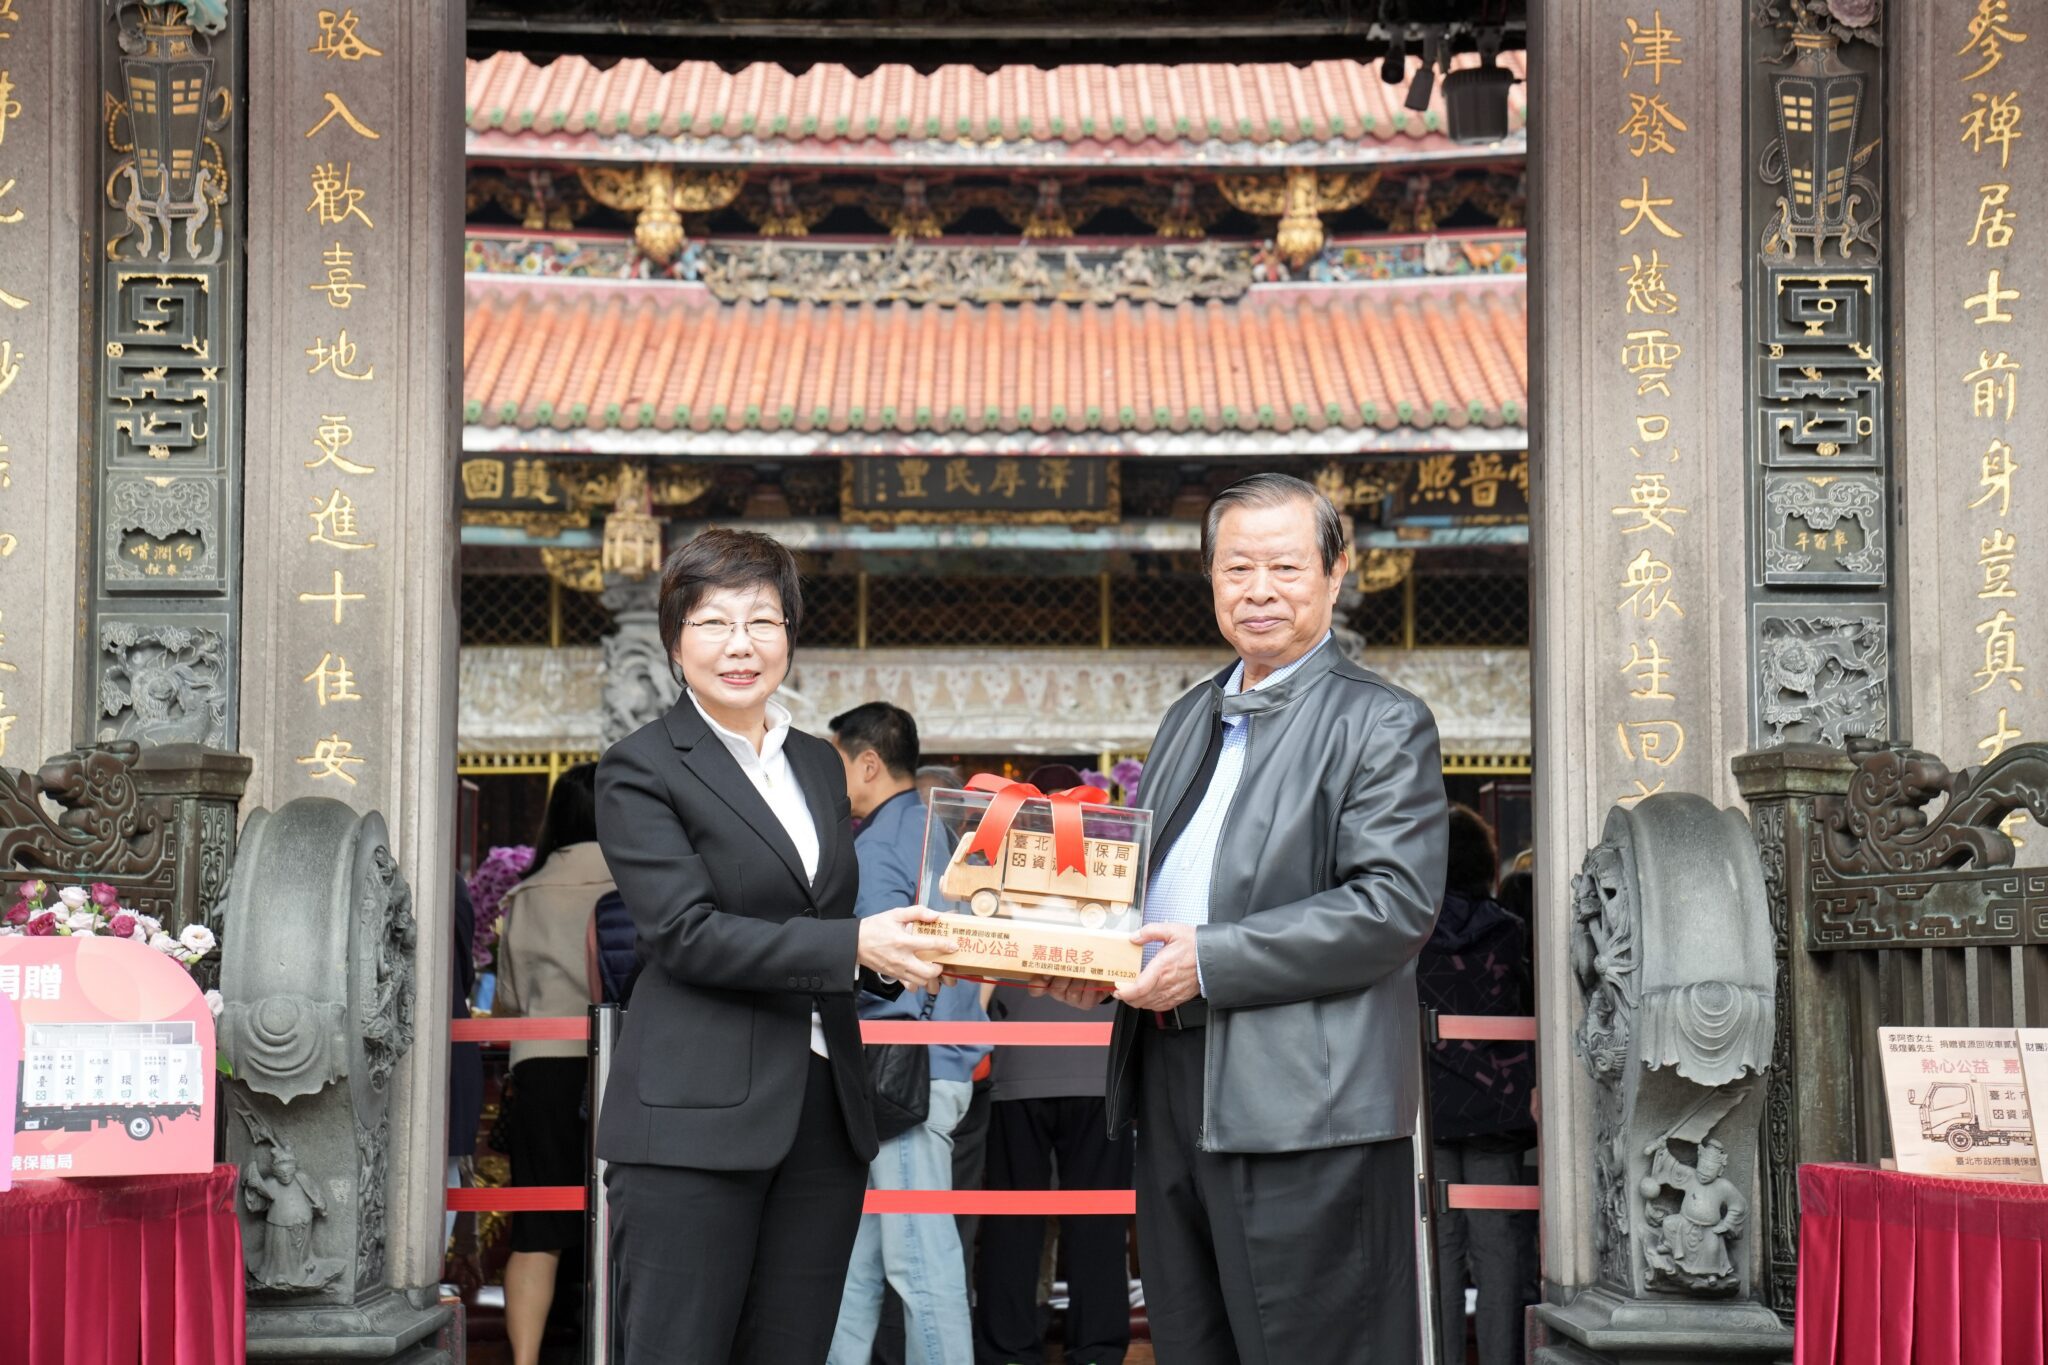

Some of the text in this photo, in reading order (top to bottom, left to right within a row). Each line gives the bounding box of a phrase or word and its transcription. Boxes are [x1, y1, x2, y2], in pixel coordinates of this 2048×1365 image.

[462, 458, 559, 504] 護國
[1013, 834, 1130, 862] 臺北保局
[1032, 854, 1128, 879] 資收車
[956, 936, 1094, 965] 熱心公益 嘉惠良多
[1921, 1059, 1989, 1075] 熱心公益
